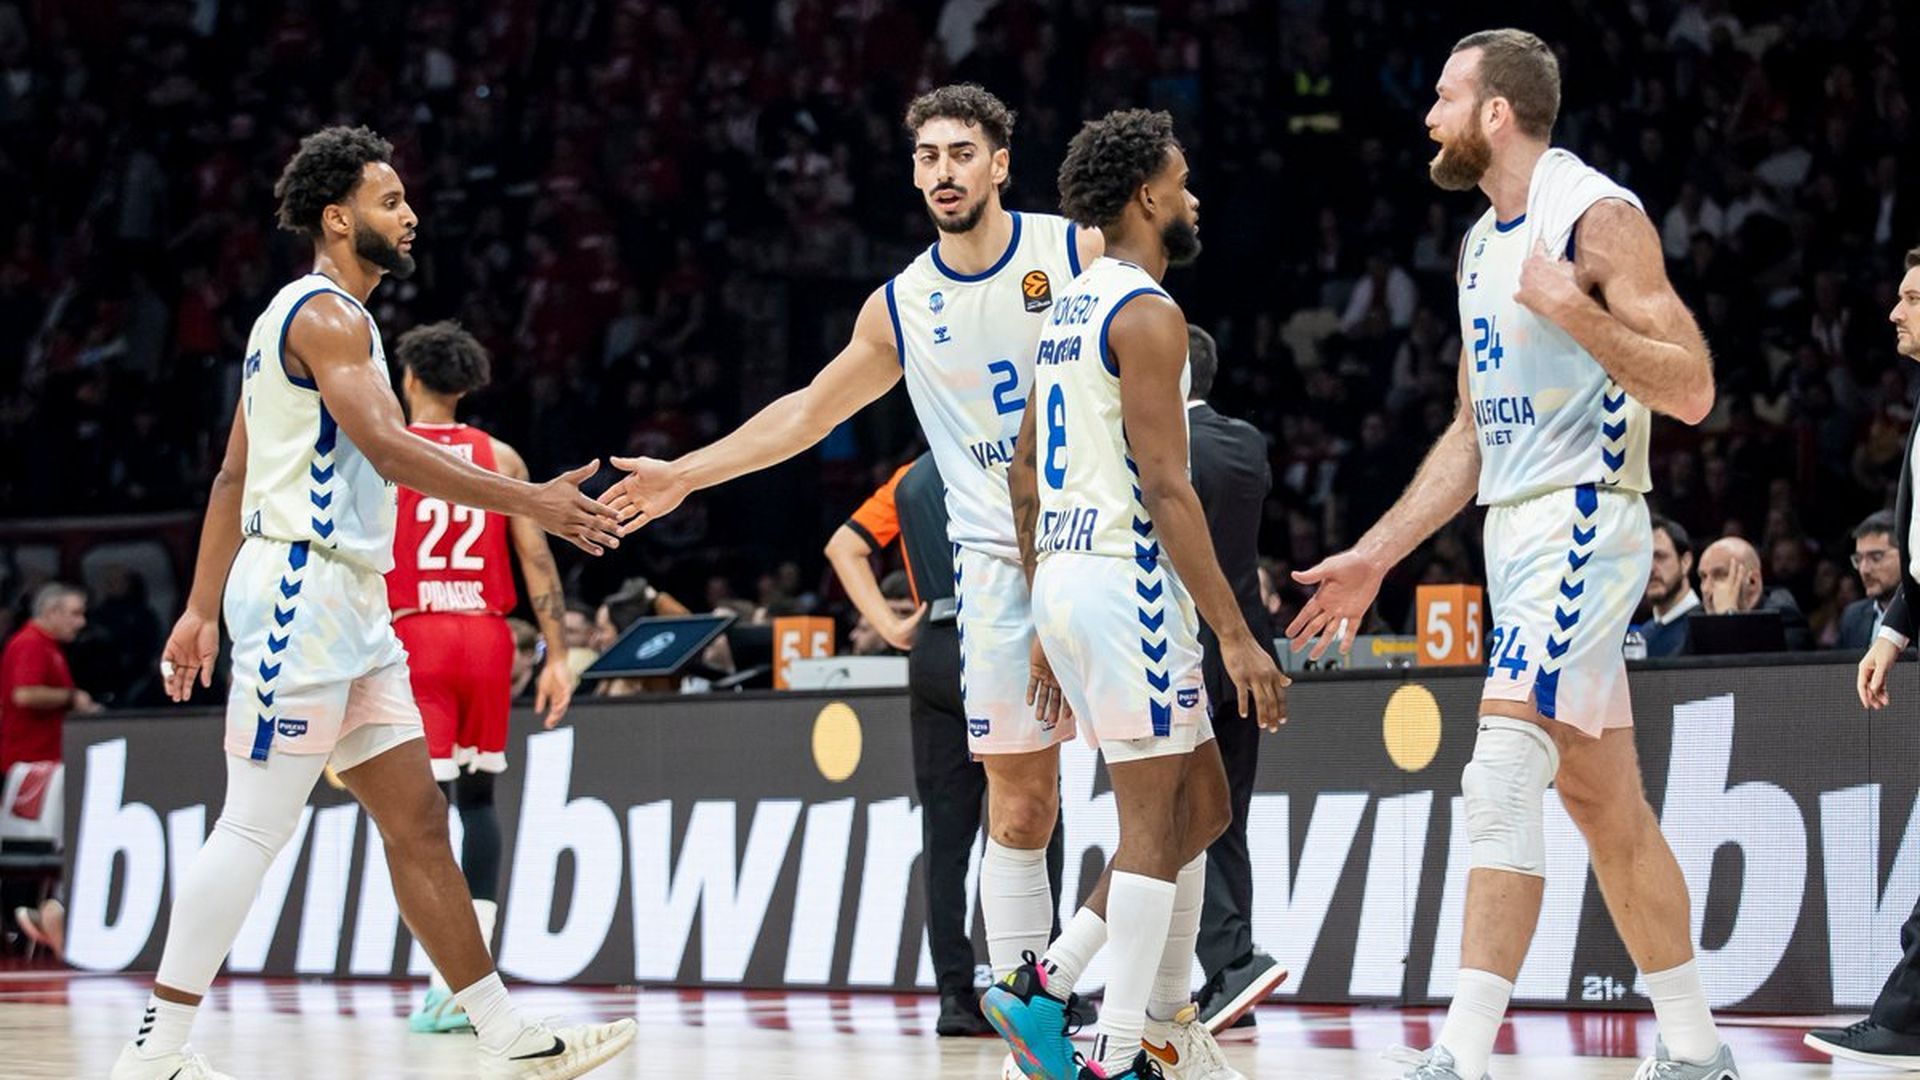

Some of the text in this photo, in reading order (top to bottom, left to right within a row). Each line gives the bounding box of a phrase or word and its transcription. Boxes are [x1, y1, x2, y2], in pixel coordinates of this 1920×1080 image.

[1473, 315, 1503, 372] 24
[988, 360, 1026, 415] 2
[1045, 384, 1067, 489] 8
[415, 497, 486, 570] 22
[417, 580, 487, 612] PIRAEUS
[1426, 601, 1479, 660] 5 5
[1487, 626, 1528, 680] 24
